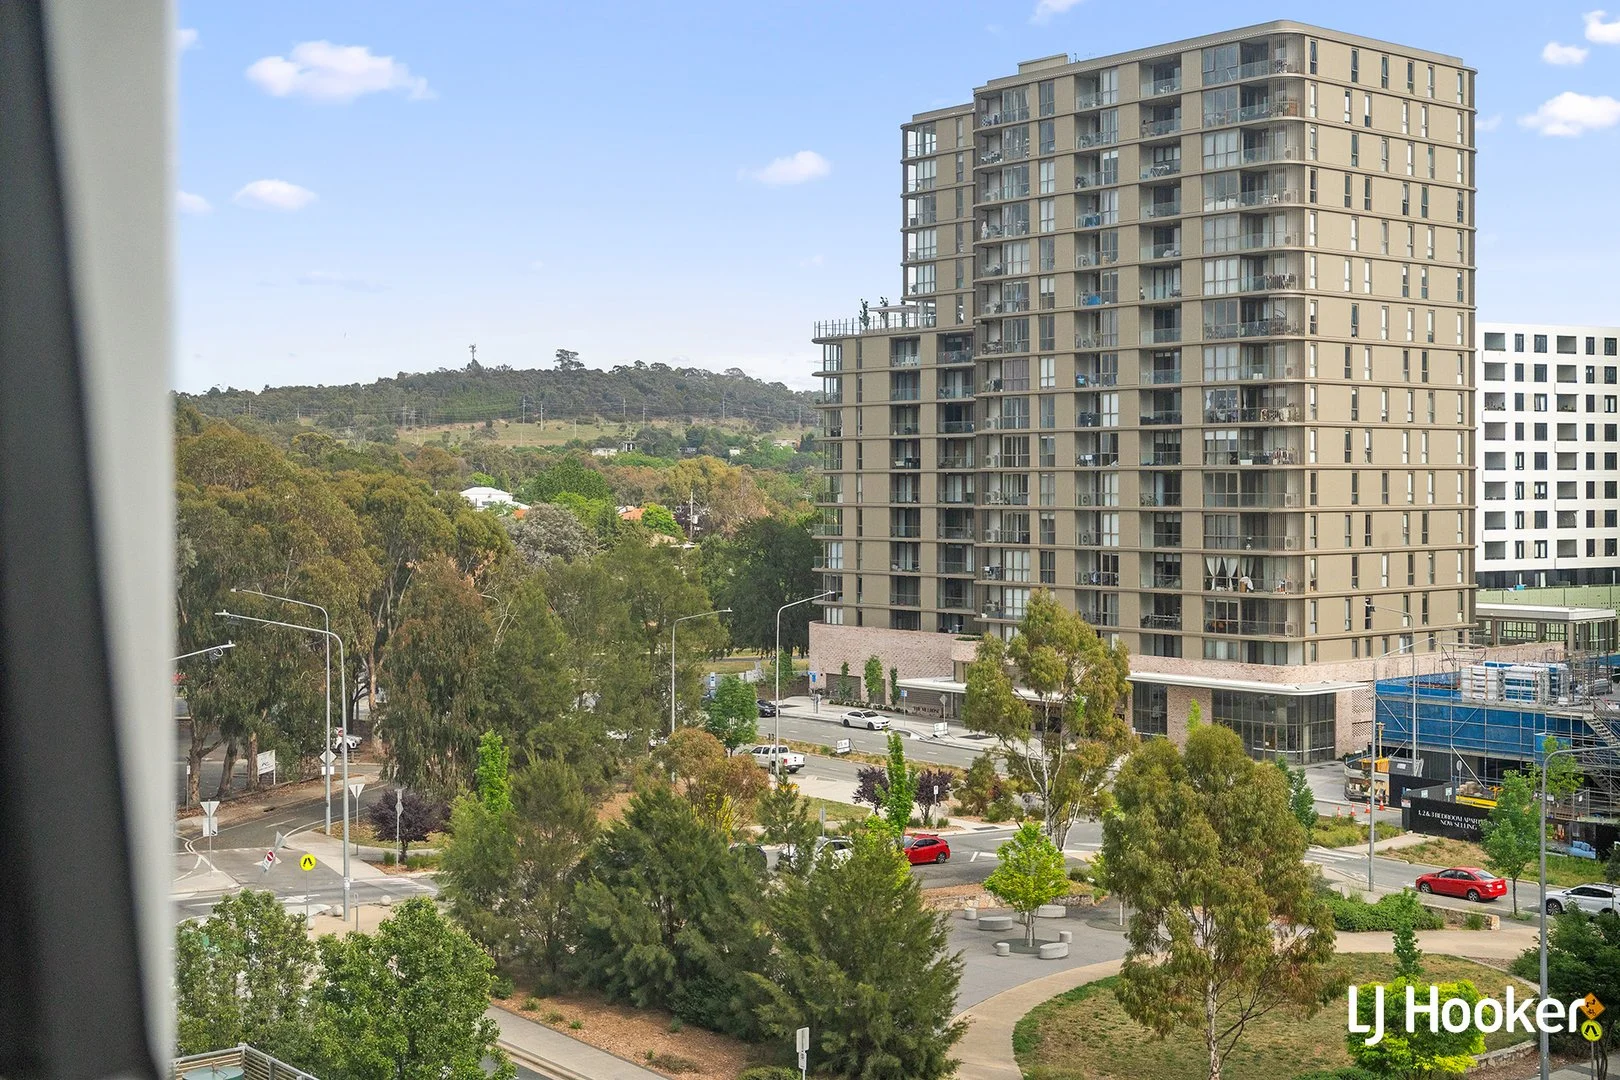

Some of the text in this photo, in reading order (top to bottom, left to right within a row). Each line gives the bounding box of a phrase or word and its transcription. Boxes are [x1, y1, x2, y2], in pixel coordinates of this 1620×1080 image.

[1435, 812, 1463, 821] BEDROOM
[1464, 816, 1500, 827] APARTNTS
[1454, 822, 1478, 830] SELLING
